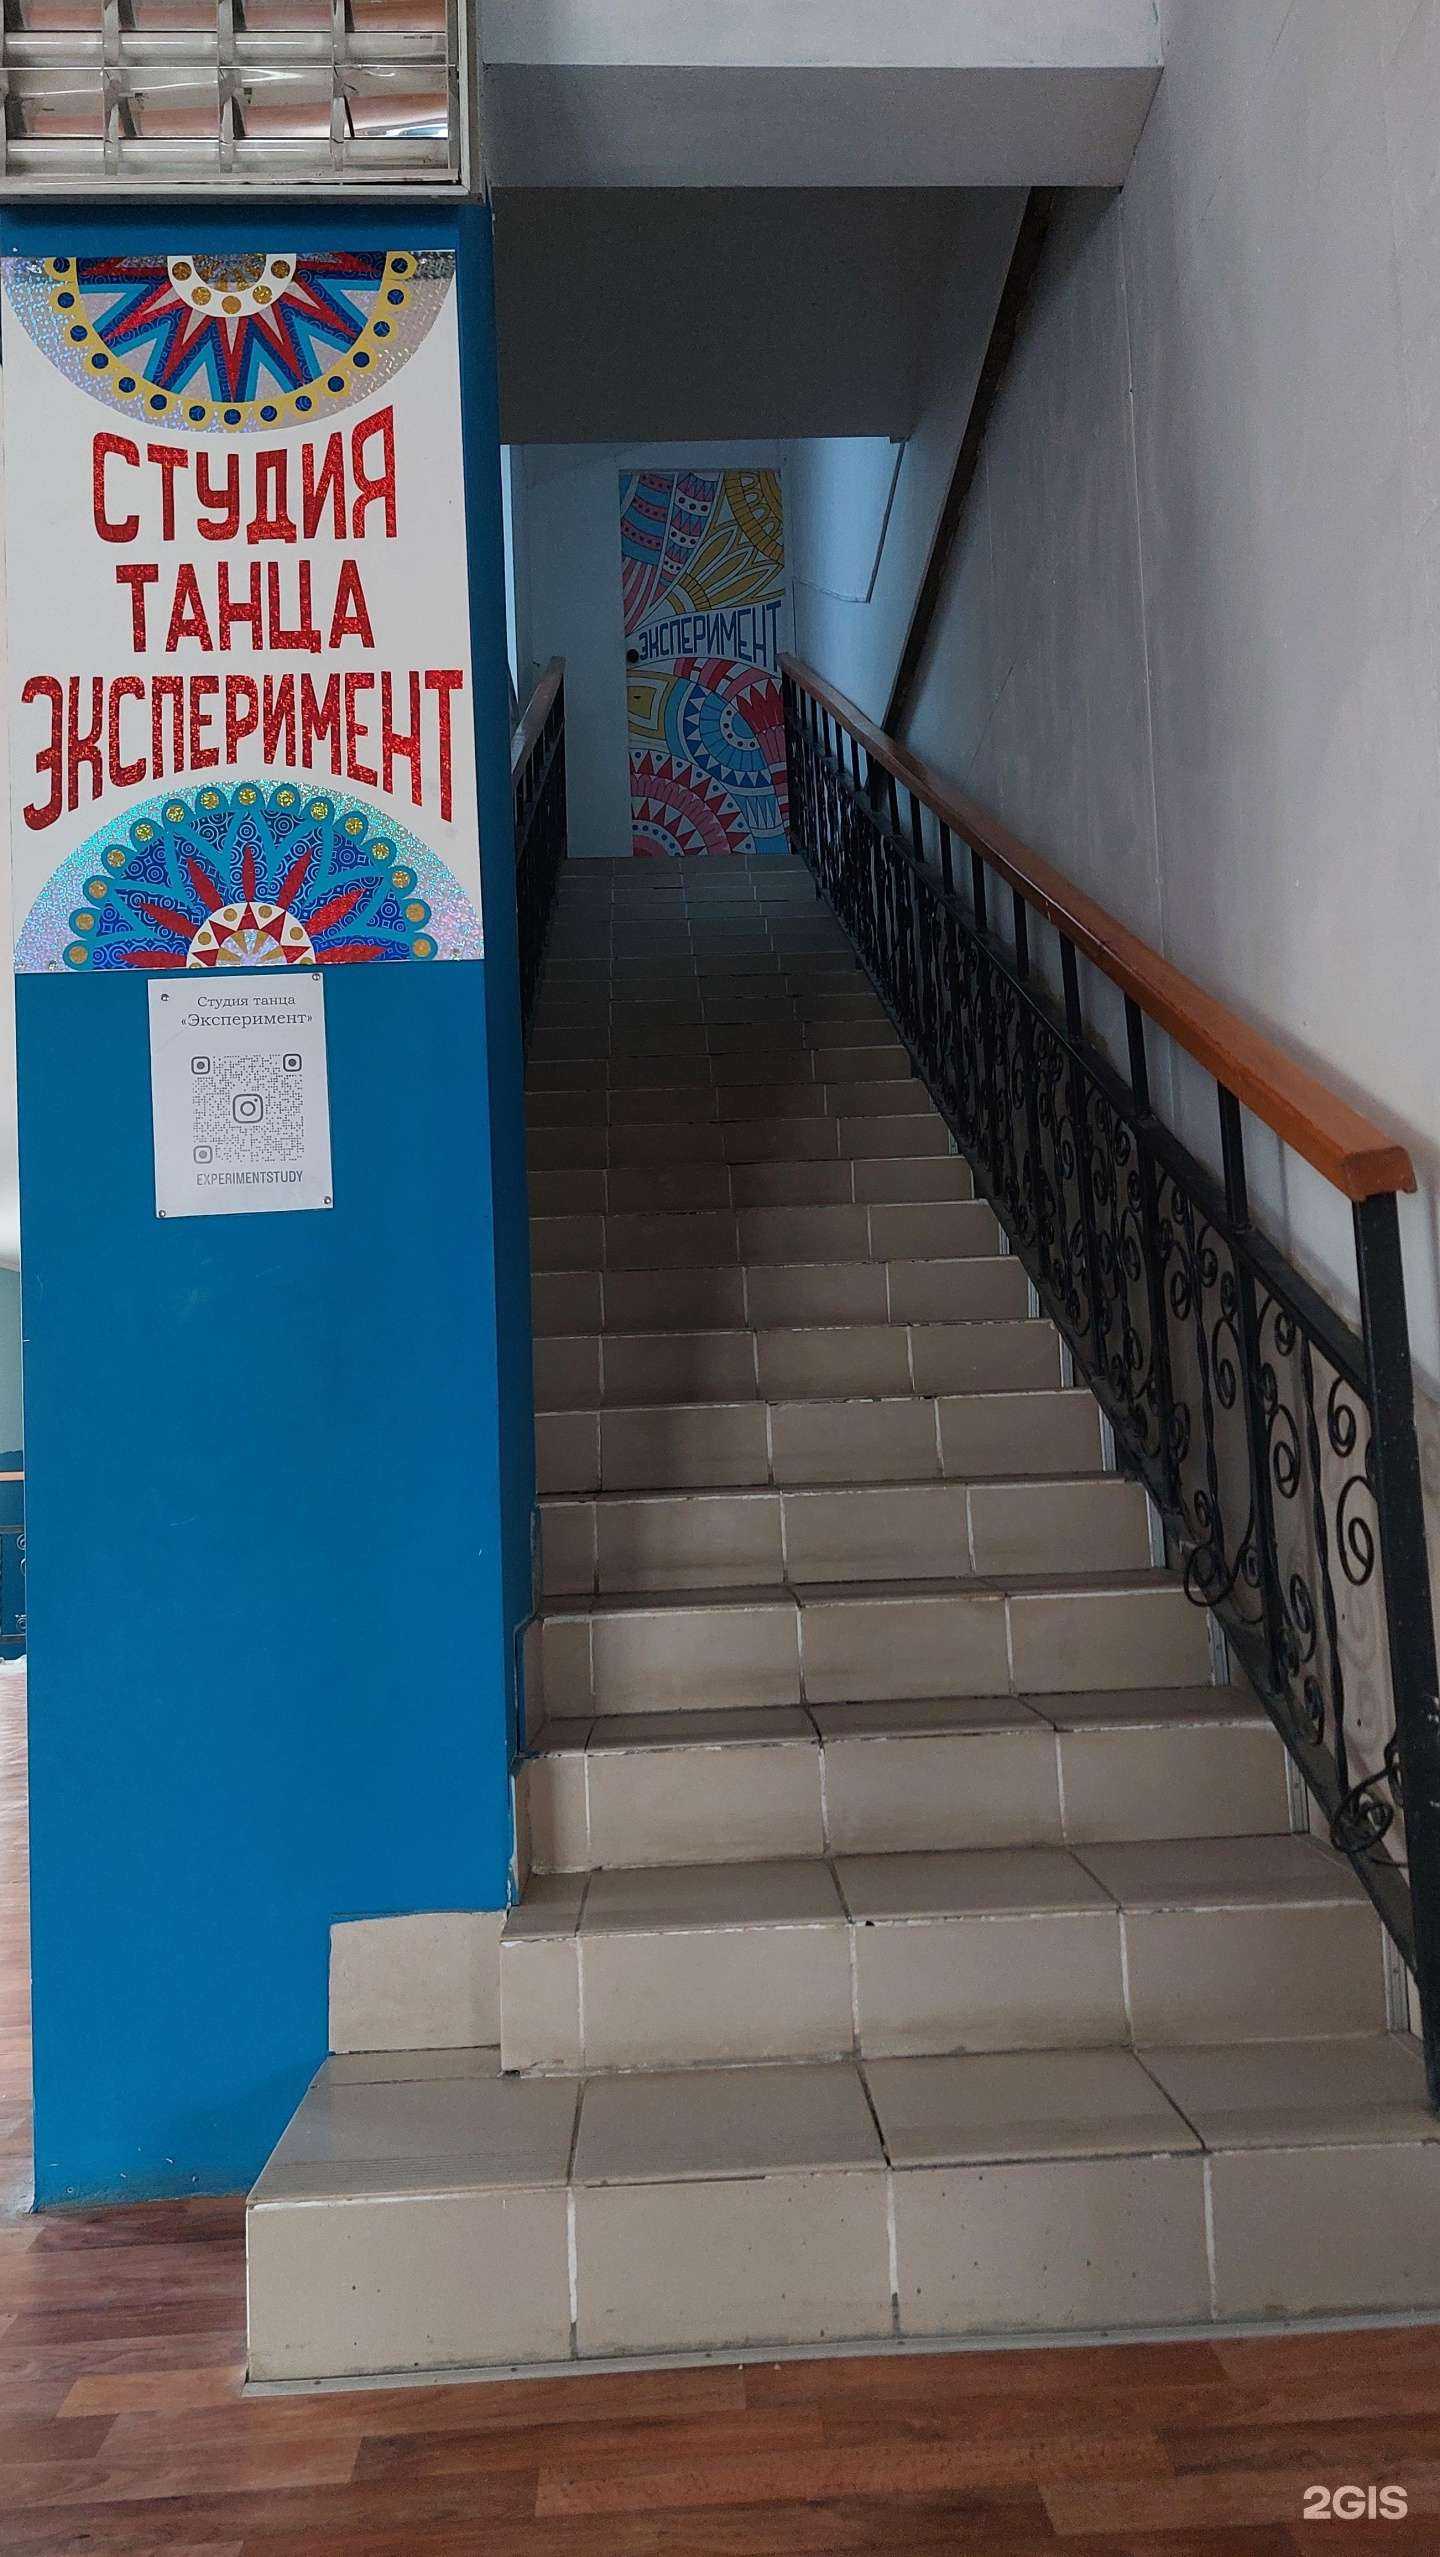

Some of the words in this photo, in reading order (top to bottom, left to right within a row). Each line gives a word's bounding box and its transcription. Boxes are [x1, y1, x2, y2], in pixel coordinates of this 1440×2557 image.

[93, 405, 397, 544] СТУДИЯ
[116, 560, 375, 653] ТАНЦА
[639, 601, 781, 672] ЭКСПЕРИМЕНТ
[21, 670, 463, 830] ЭКСПЕРИМЕНТ
[181, 1013, 312, 1028] «Эксперимент»
[197, 996, 248, 1009] Студия
[253, 995, 296, 1006] танца
[196, 1170, 303, 1185] EXPERIMENTSTUDY
